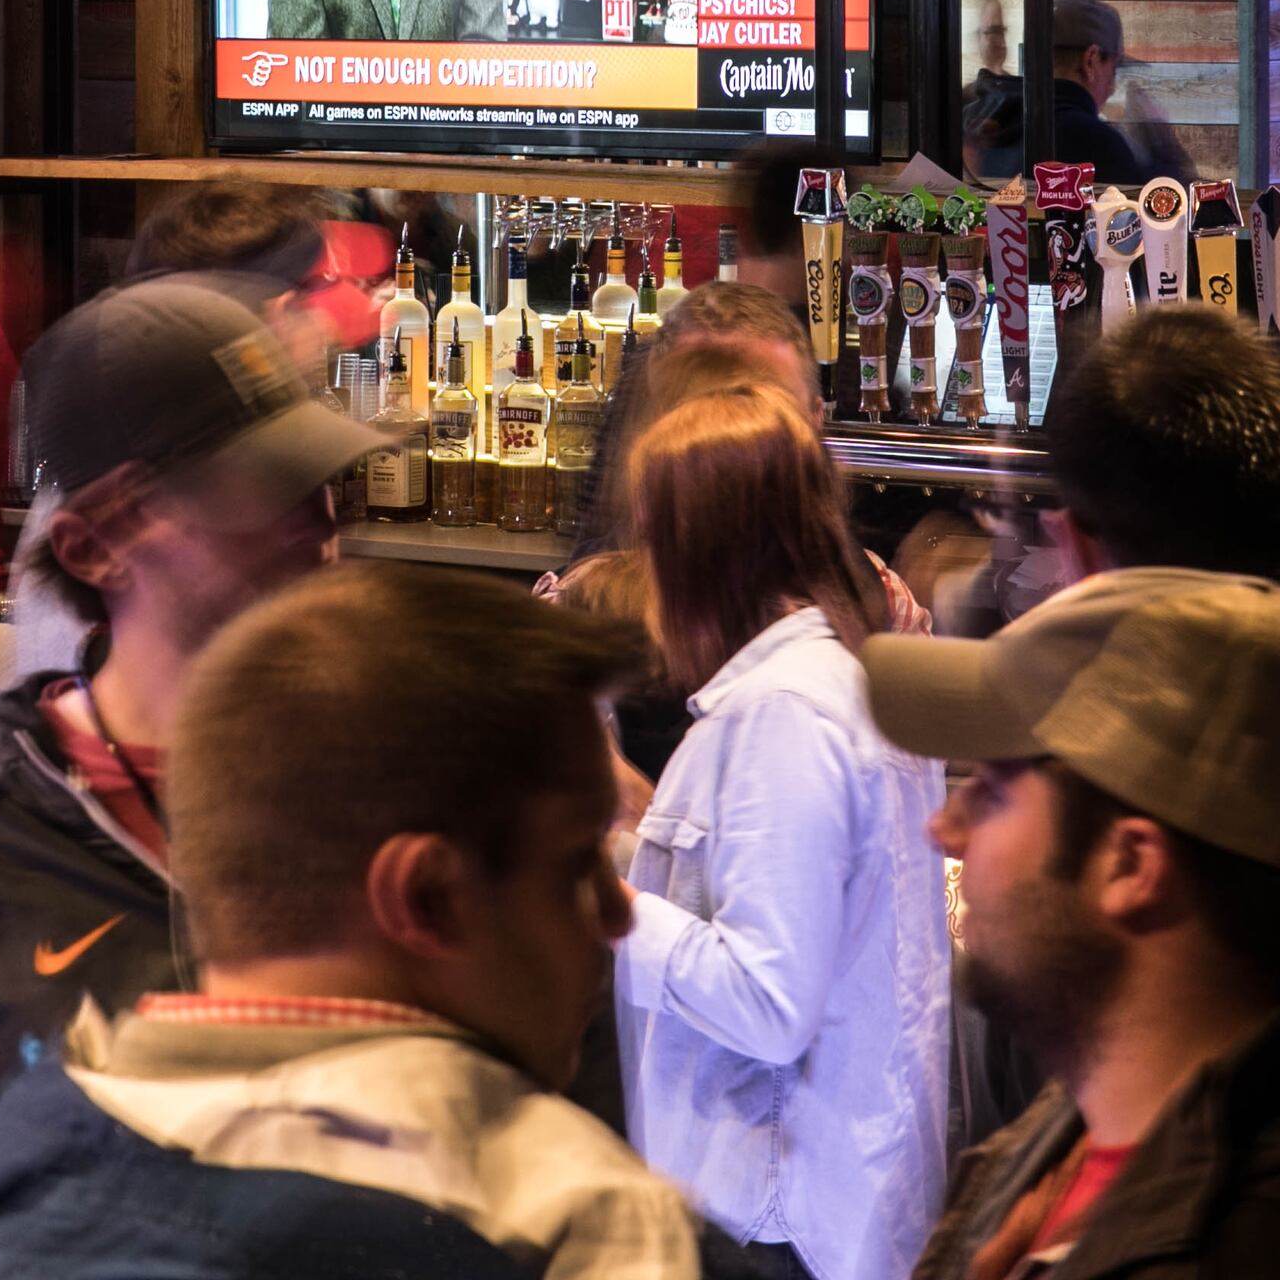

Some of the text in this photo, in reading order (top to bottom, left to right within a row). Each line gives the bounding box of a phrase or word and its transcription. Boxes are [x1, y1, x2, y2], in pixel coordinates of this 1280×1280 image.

[605, 0, 631, 27] PTI
[699, 22, 802, 45] JAY CUTLER
[295, 56, 598, 89] NOT ENOUGH COMPETITION?
[720, 57, 782, 98] Captain
[242, 103, 299, 117] ESPN APP
[309, 106, 639, 128] All games on ESPN Networks streaming live on ESPN app
[1041, 191, 1058, 199] HIGH
[1106, 228, 1132, 247] BLUE
[995, 205, 1028, 343] Coors
[807, 259, 825, 324] Coors
[1007, 367, 1025, 387] A
[499, 408, 538, 421] SMIRNOFF
